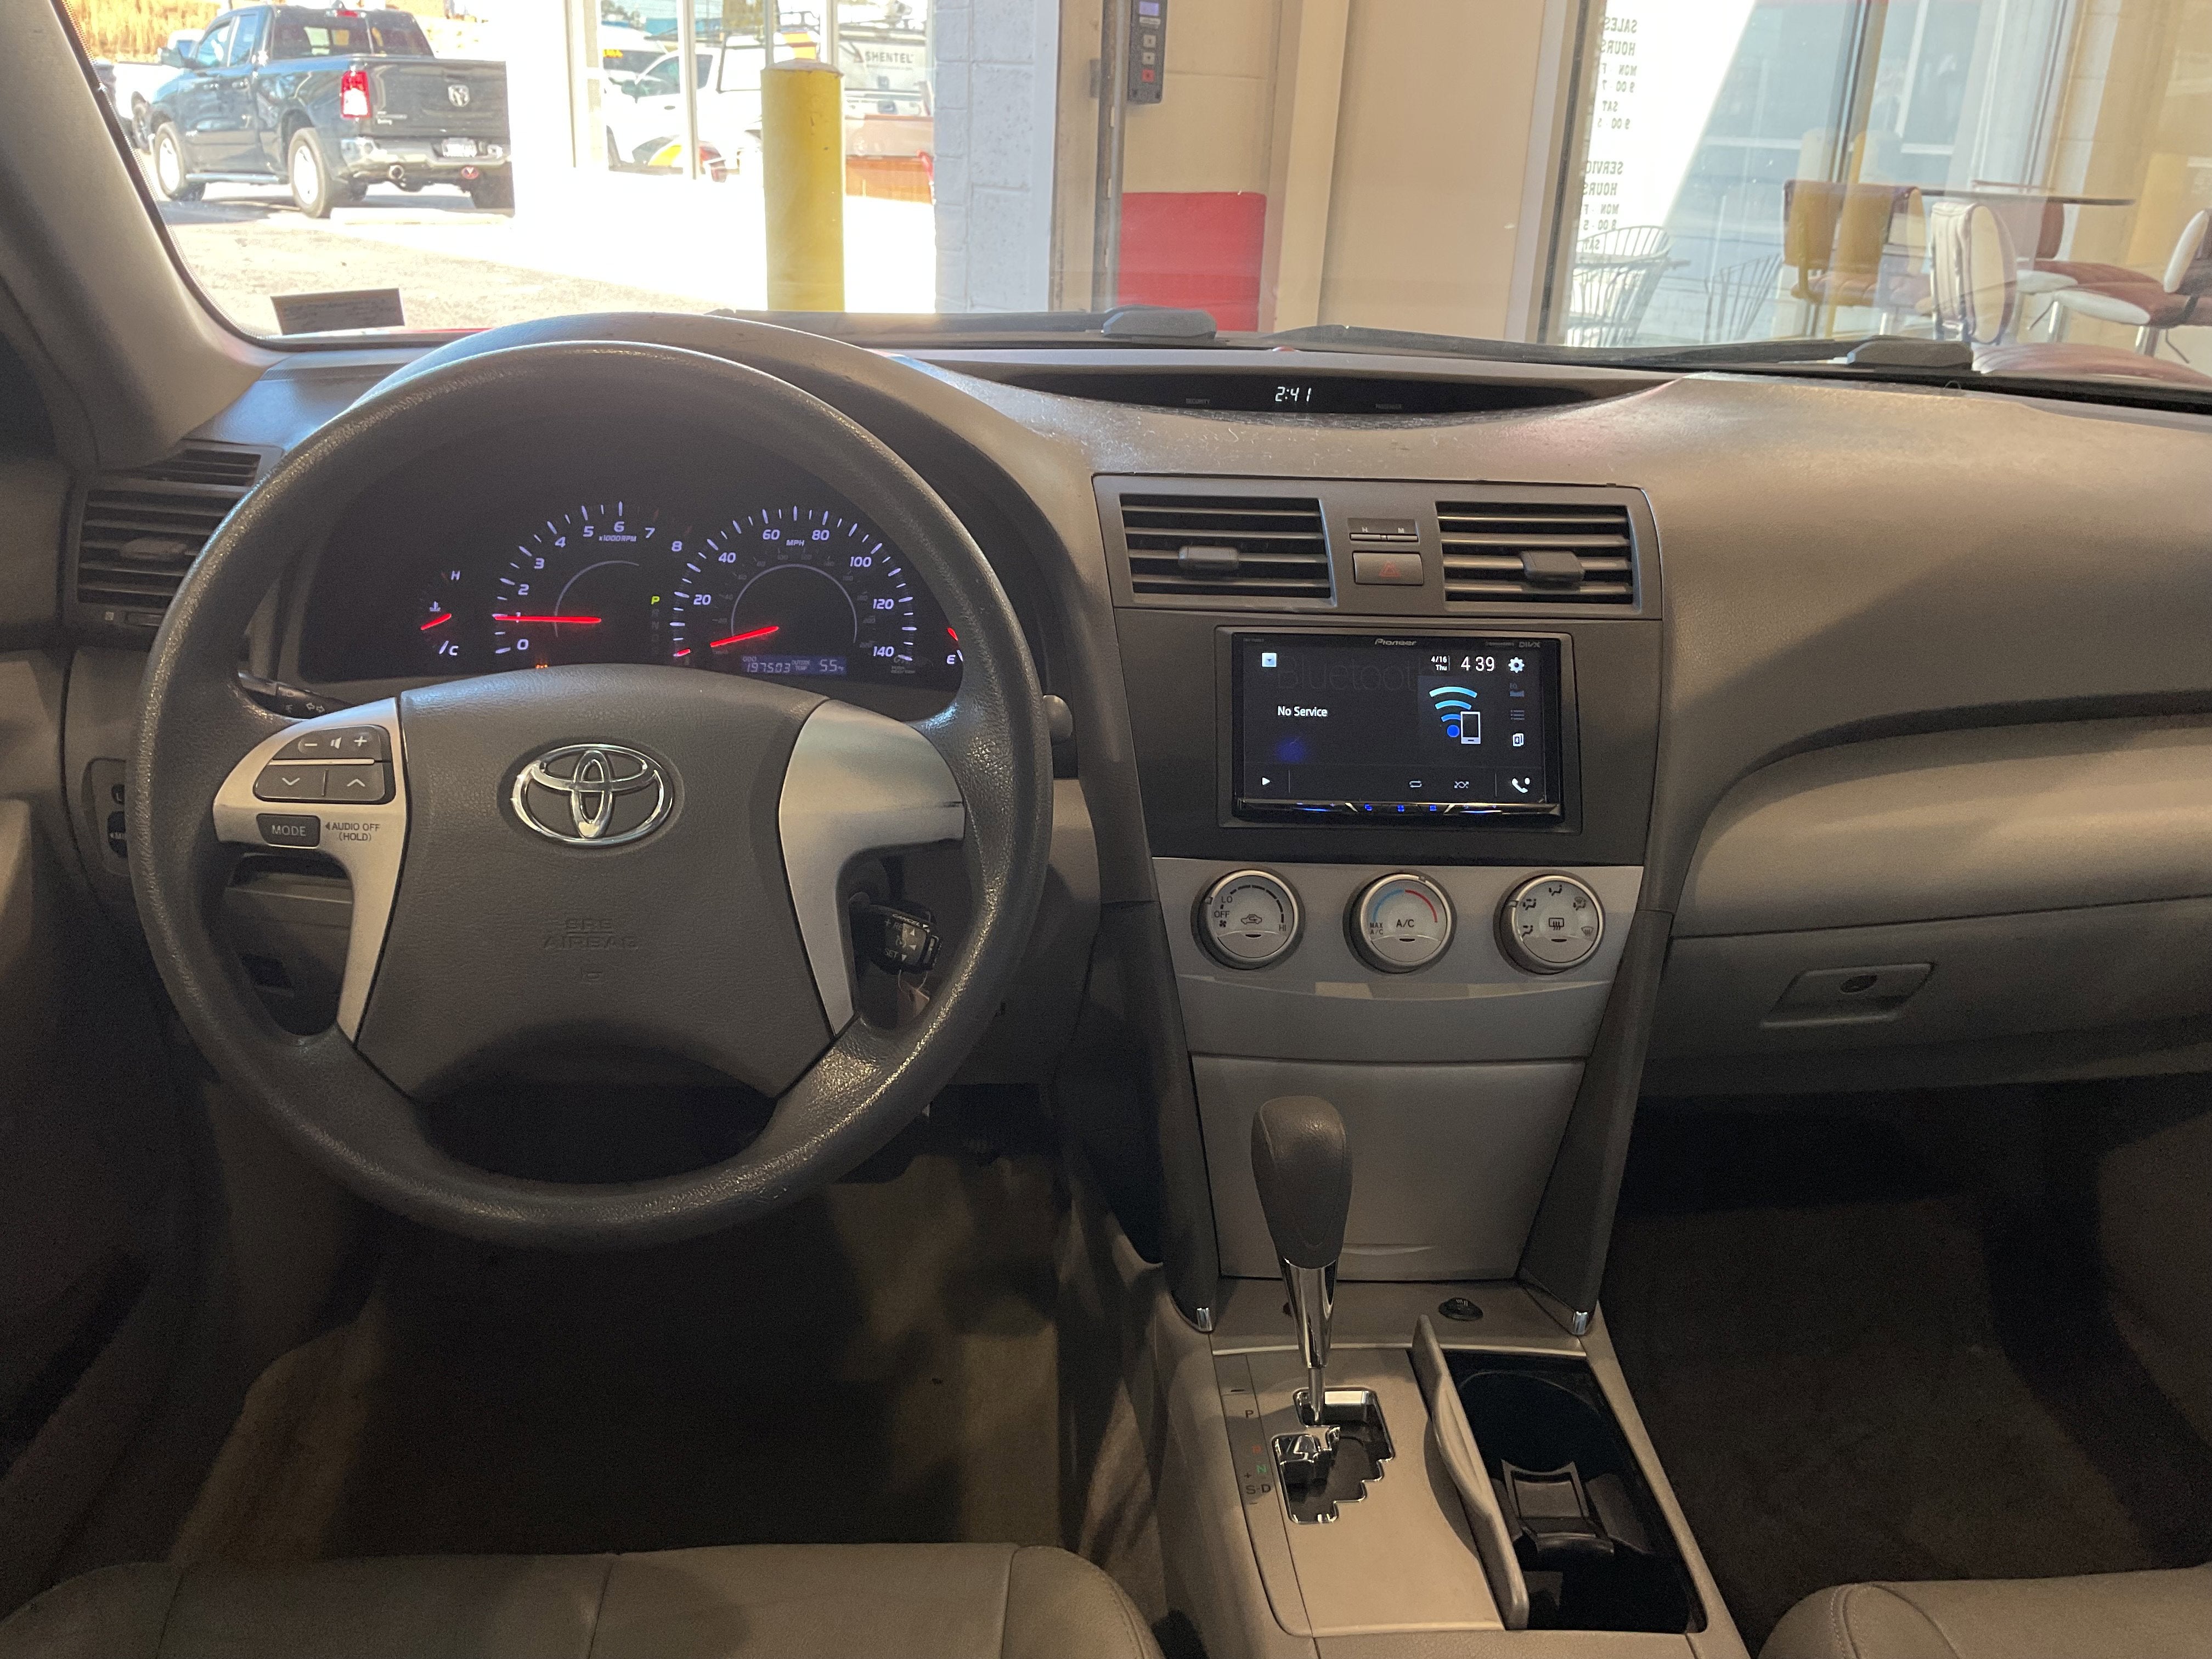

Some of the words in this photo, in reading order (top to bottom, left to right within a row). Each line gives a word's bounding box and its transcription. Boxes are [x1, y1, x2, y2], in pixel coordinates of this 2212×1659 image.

[865, 51, 912, 63] SHENTEL
[1275, 386, 1312, 402] 2:41
[583, 526, 594, 537] 5
[613, 521, 625, 532] 6
[645, 527, 656, 538] 7
[762, 529, 780, 540] 60
[812, 529, 830, 540] 80
[555, 537, 566, 548] 4
[671, 541, 682, 552] 8
[534, 557, 545, 569] 3
[718, 552, 736, 563] 40
[850, 556, 872, 567] 100
[451, 571, 460, 580] H
[518, 584, 529, 595] 2
[651, 595, 660, 605] P
[693, 594, 711, 605] 20
[873, 599, 894, 610] 120
[517, 639, 529, 650] 0
[1374, 637, 1417, 646] Pioneer
[448, 645, 459, 656] C
[873, 646, 894, 657] 140
[946, 654, 956, 664] E
[1431, 656, 1448, 664] 4/16
[747, 662, 791, 673] 197503
[1277, 706, 1291, 716] No
[1293, 706, 1328, 718] Service
[272, 825, 307, 837] MODE
[332, 823, 359, 831] AUDIO
[363, 823, 381, 832] OFF
[338, 832, 371, 842] (HOLD)
[892, 913, 921, 927] CANCEL
[1396, 919, 1415, 928] A/C
[885, 948, 899, 959] SET
[1245, 1410, 1254, 1418] P
[1256, 1464, 1267, 1474] N
